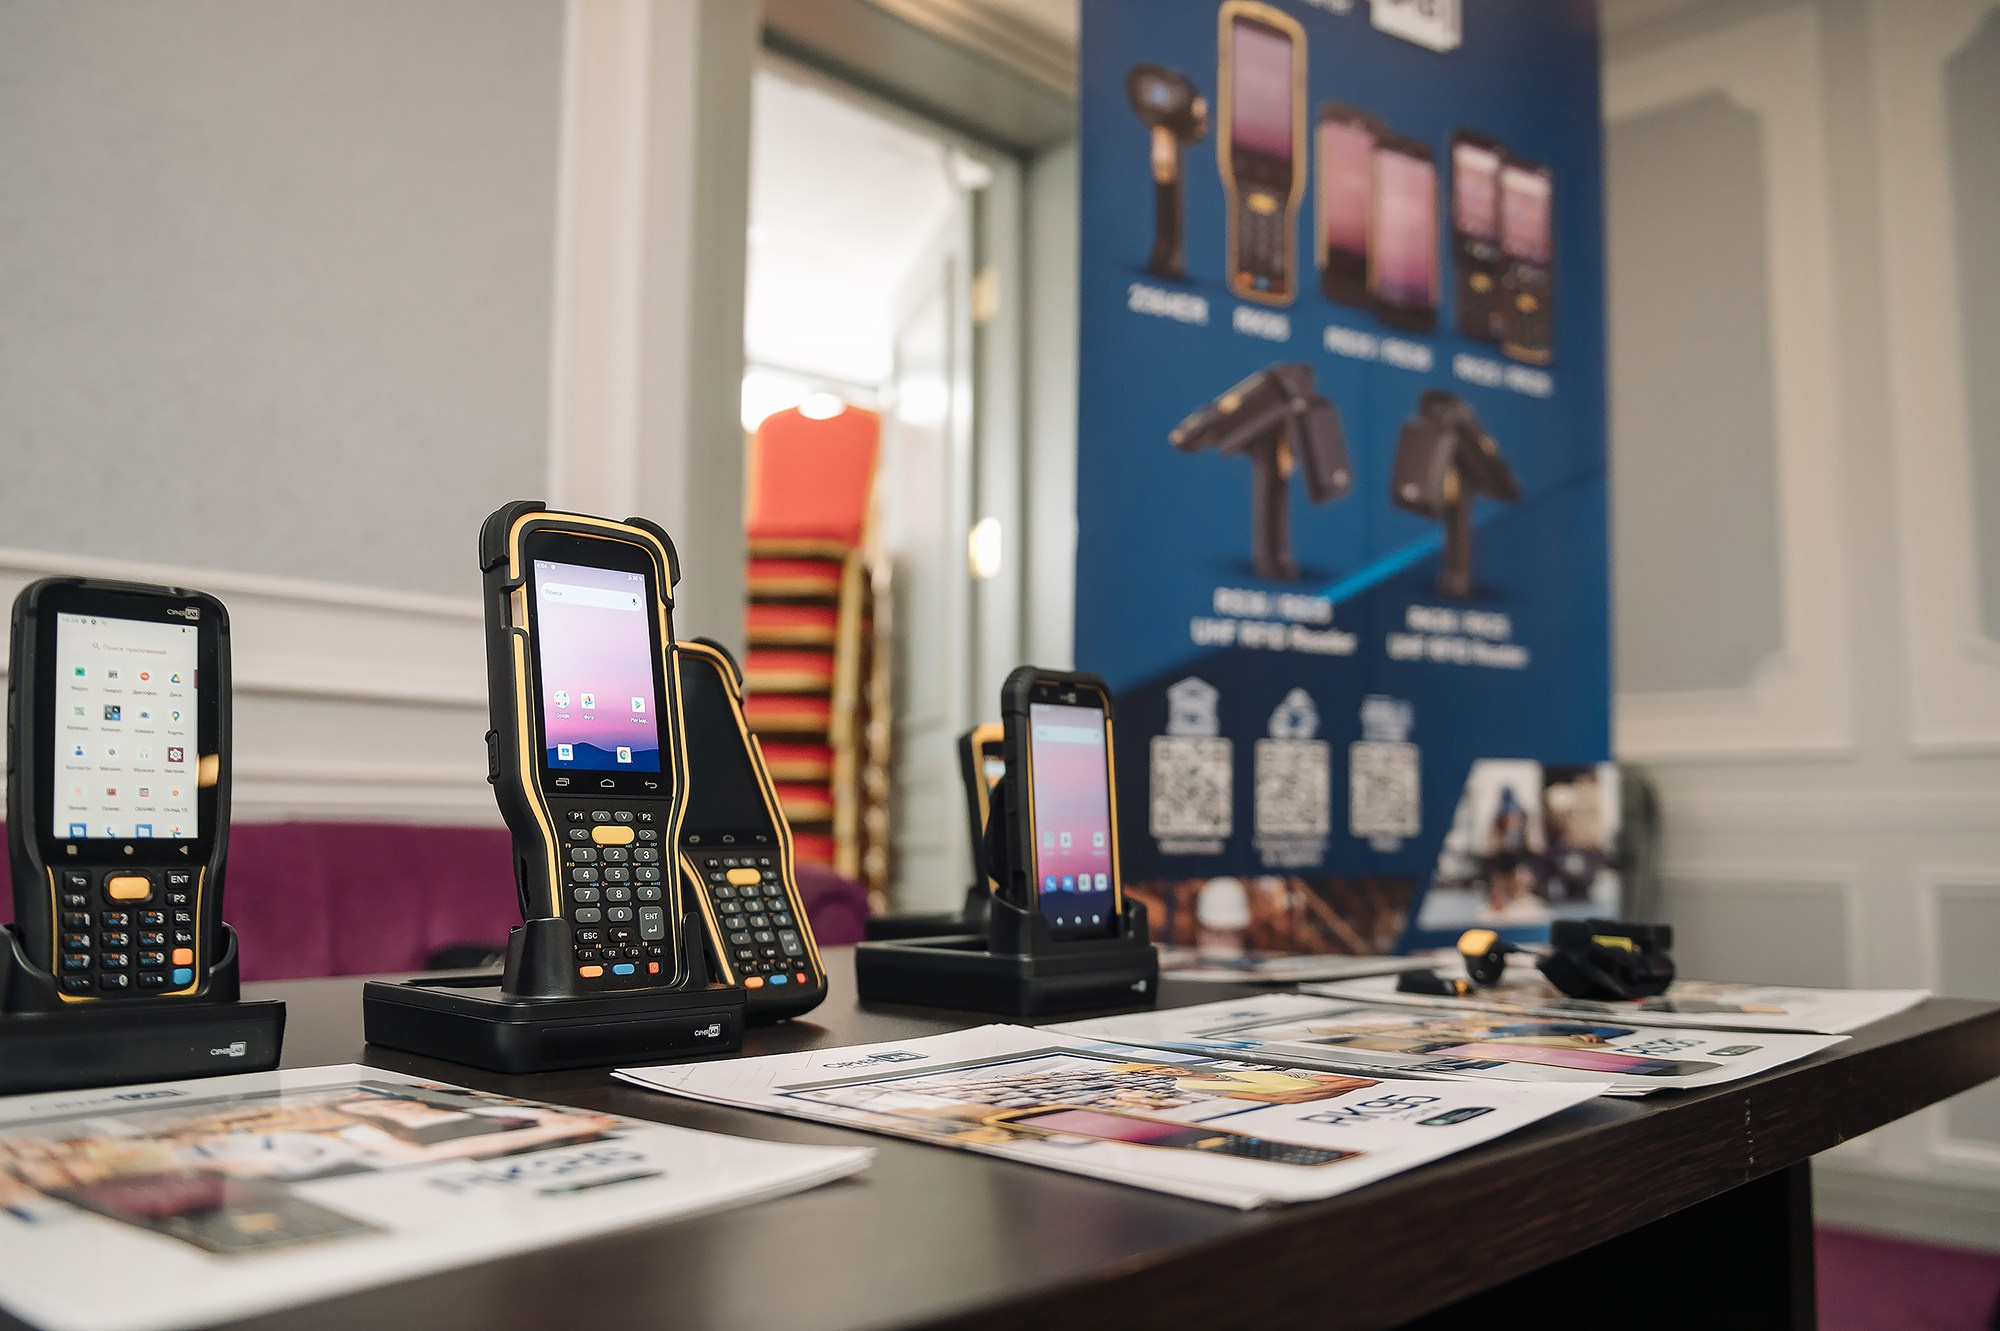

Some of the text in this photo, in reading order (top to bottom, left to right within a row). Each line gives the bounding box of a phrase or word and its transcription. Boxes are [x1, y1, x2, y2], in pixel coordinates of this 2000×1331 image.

[583, 851, 587, 859] 1
[613, 851, 619, 859] 2
[644, 851, 650, 859] 3
[583, 871, 590, 879] 4
[615, 870, 620, 879] 5
[645, 870, 651, 878] 6
[171, 875, 189, 884] ENT
[173, 894, 186, 903] P2
[584, 891, 590, 899] 7
[616, 890, 622, 898] 8
[647, 890, 653, 898] 9
[72, 895, 86, 905] P1
[156, 912, 164, 924] 3
[618, 910, 624, 918] 0
[84, 913, 90, 926] 1
[120, 913, 129, 925] 2
[82, 935, 90, 948] 4
[120, 933, 128, 946] 5
[156, 933, 164, 944] 6
[82, 955, 90, 968] 7
[119, 954, 128, 966] 8
[156, 953, 165, 964] 9
[119, 974, 129, 988] 0
